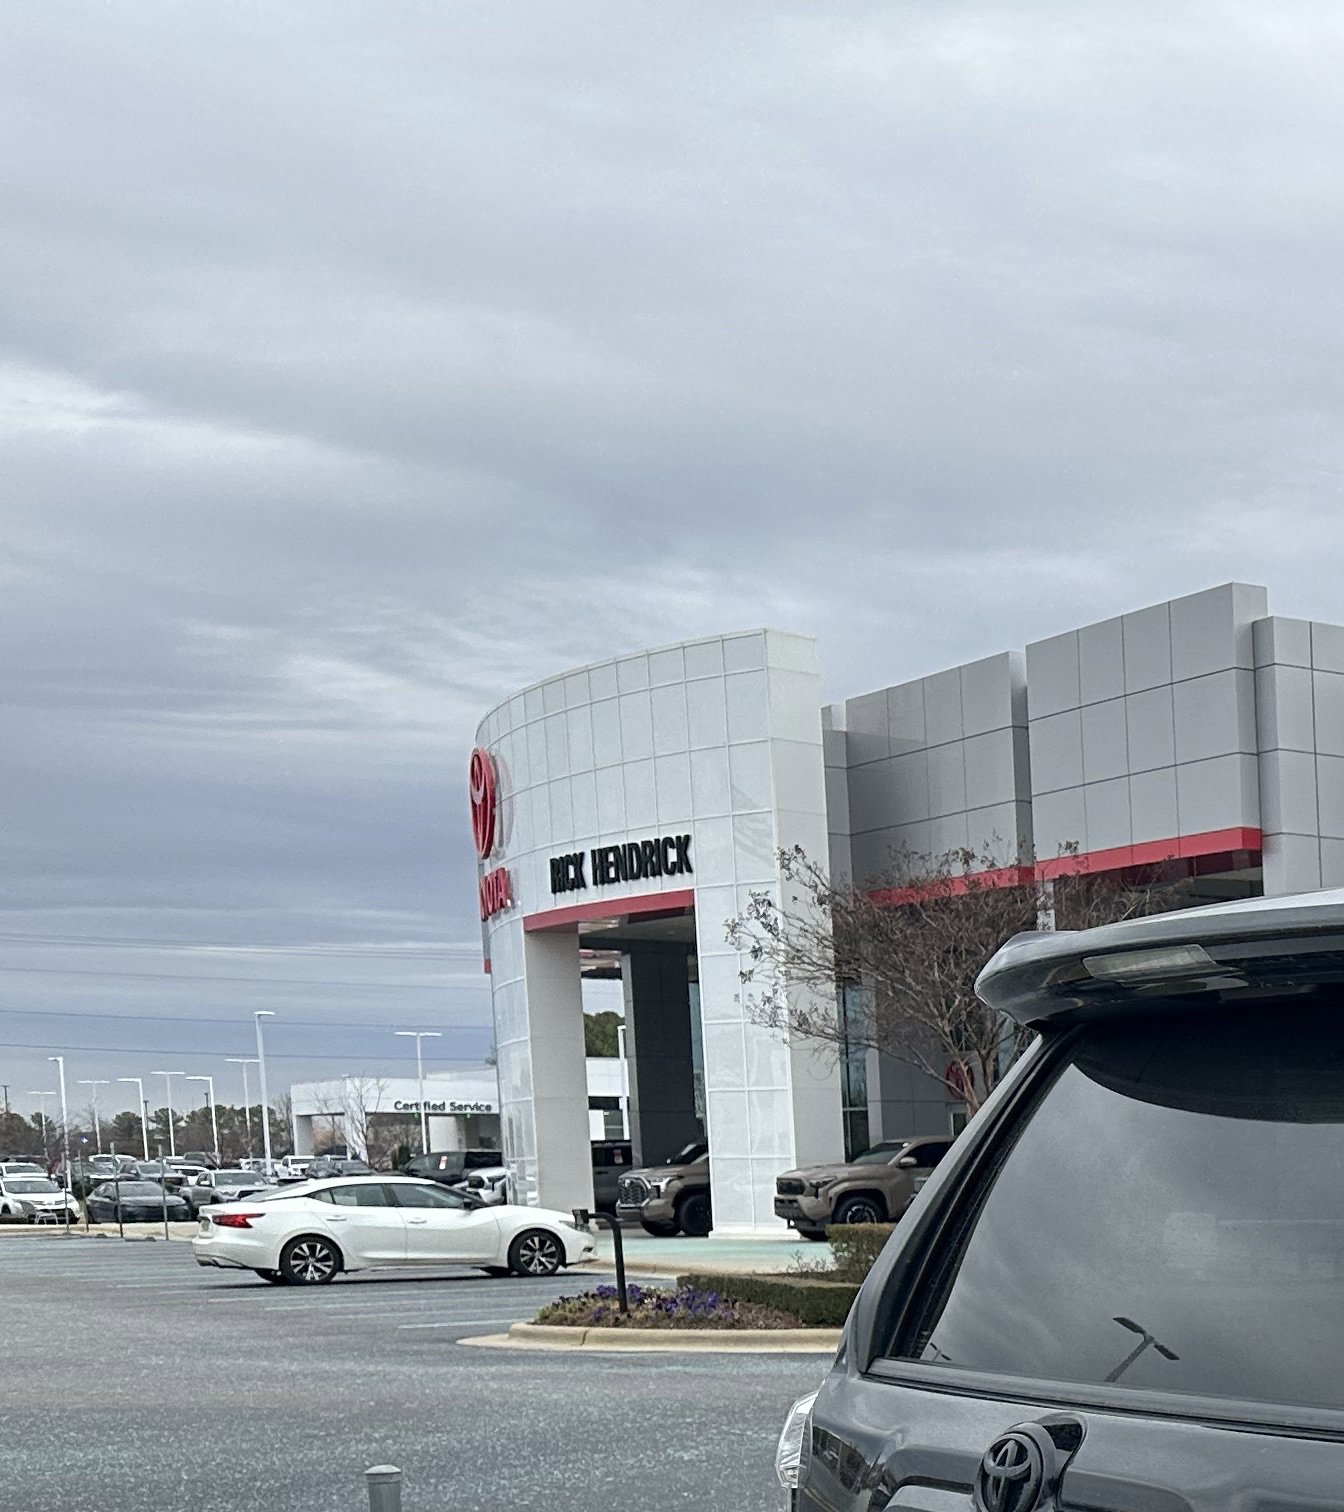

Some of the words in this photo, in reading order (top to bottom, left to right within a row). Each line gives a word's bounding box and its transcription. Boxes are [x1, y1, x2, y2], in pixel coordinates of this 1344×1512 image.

[550, 852, 587, 894] RICK
[590, 834, 693, 887] HENDRICK
[394, 1101, 446, 1112] Certfied
[450, 1102, 492, 1112] Service
